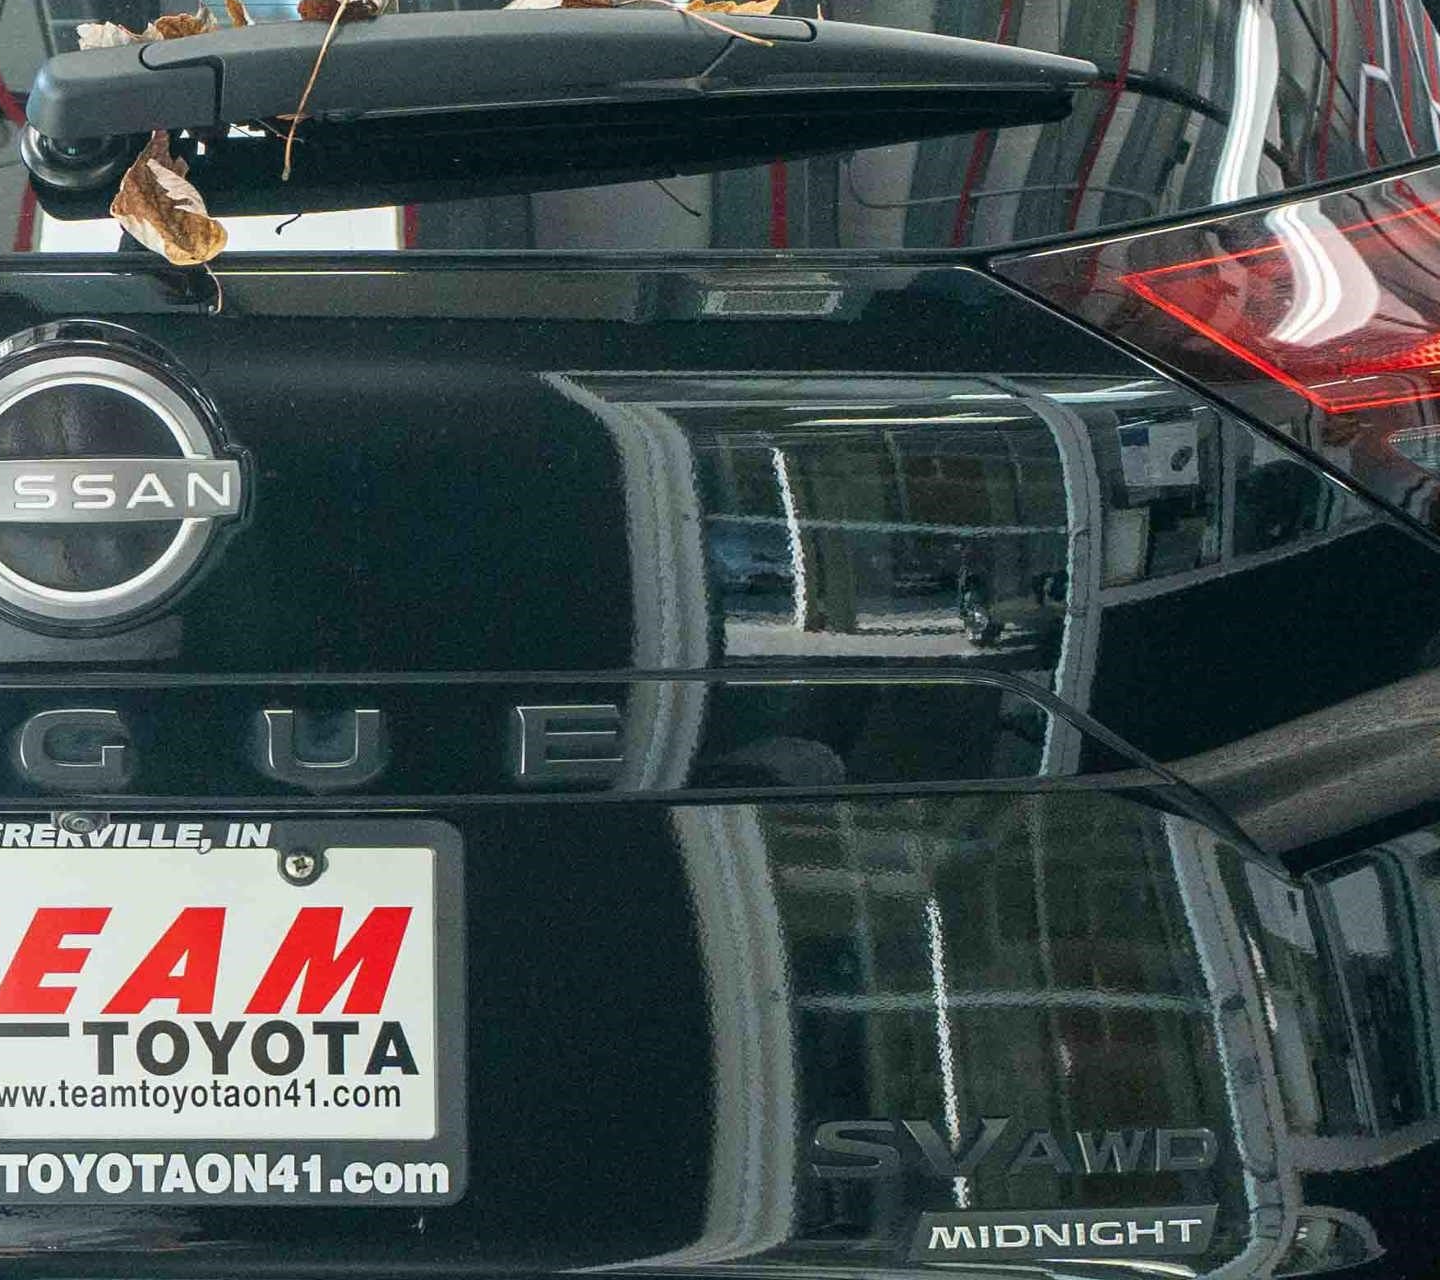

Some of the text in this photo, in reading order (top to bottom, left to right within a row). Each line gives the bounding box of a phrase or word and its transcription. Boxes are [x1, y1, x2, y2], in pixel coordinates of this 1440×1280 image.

[225, 822, 272, 848] IN
[82, 1020, 420, 1076] TOYOTA
[812, 1118, 1218, 1179] SV AWD
[928, 1218, 1202, 1250] MIDNIGHT
